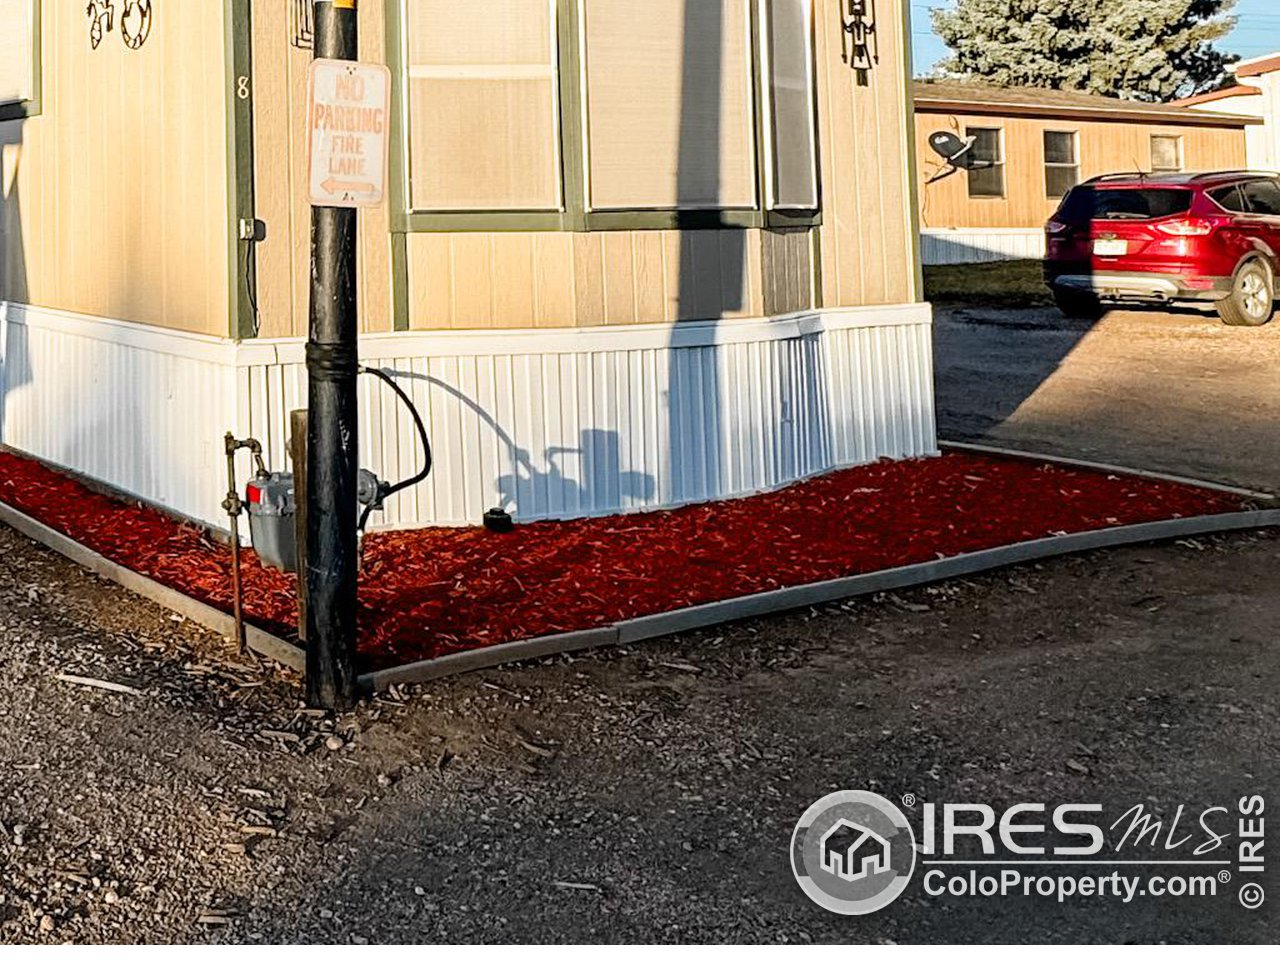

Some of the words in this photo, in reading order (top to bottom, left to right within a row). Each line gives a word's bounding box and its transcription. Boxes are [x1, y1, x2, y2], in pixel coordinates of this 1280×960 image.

[238, 75, 249, 99] 8
[336, 74, 365, 101] NO
[314, 103, 383, 134] PARKING
[332, 135, 364, 155] FIRE
[328, 156, 367, 176] LANE
